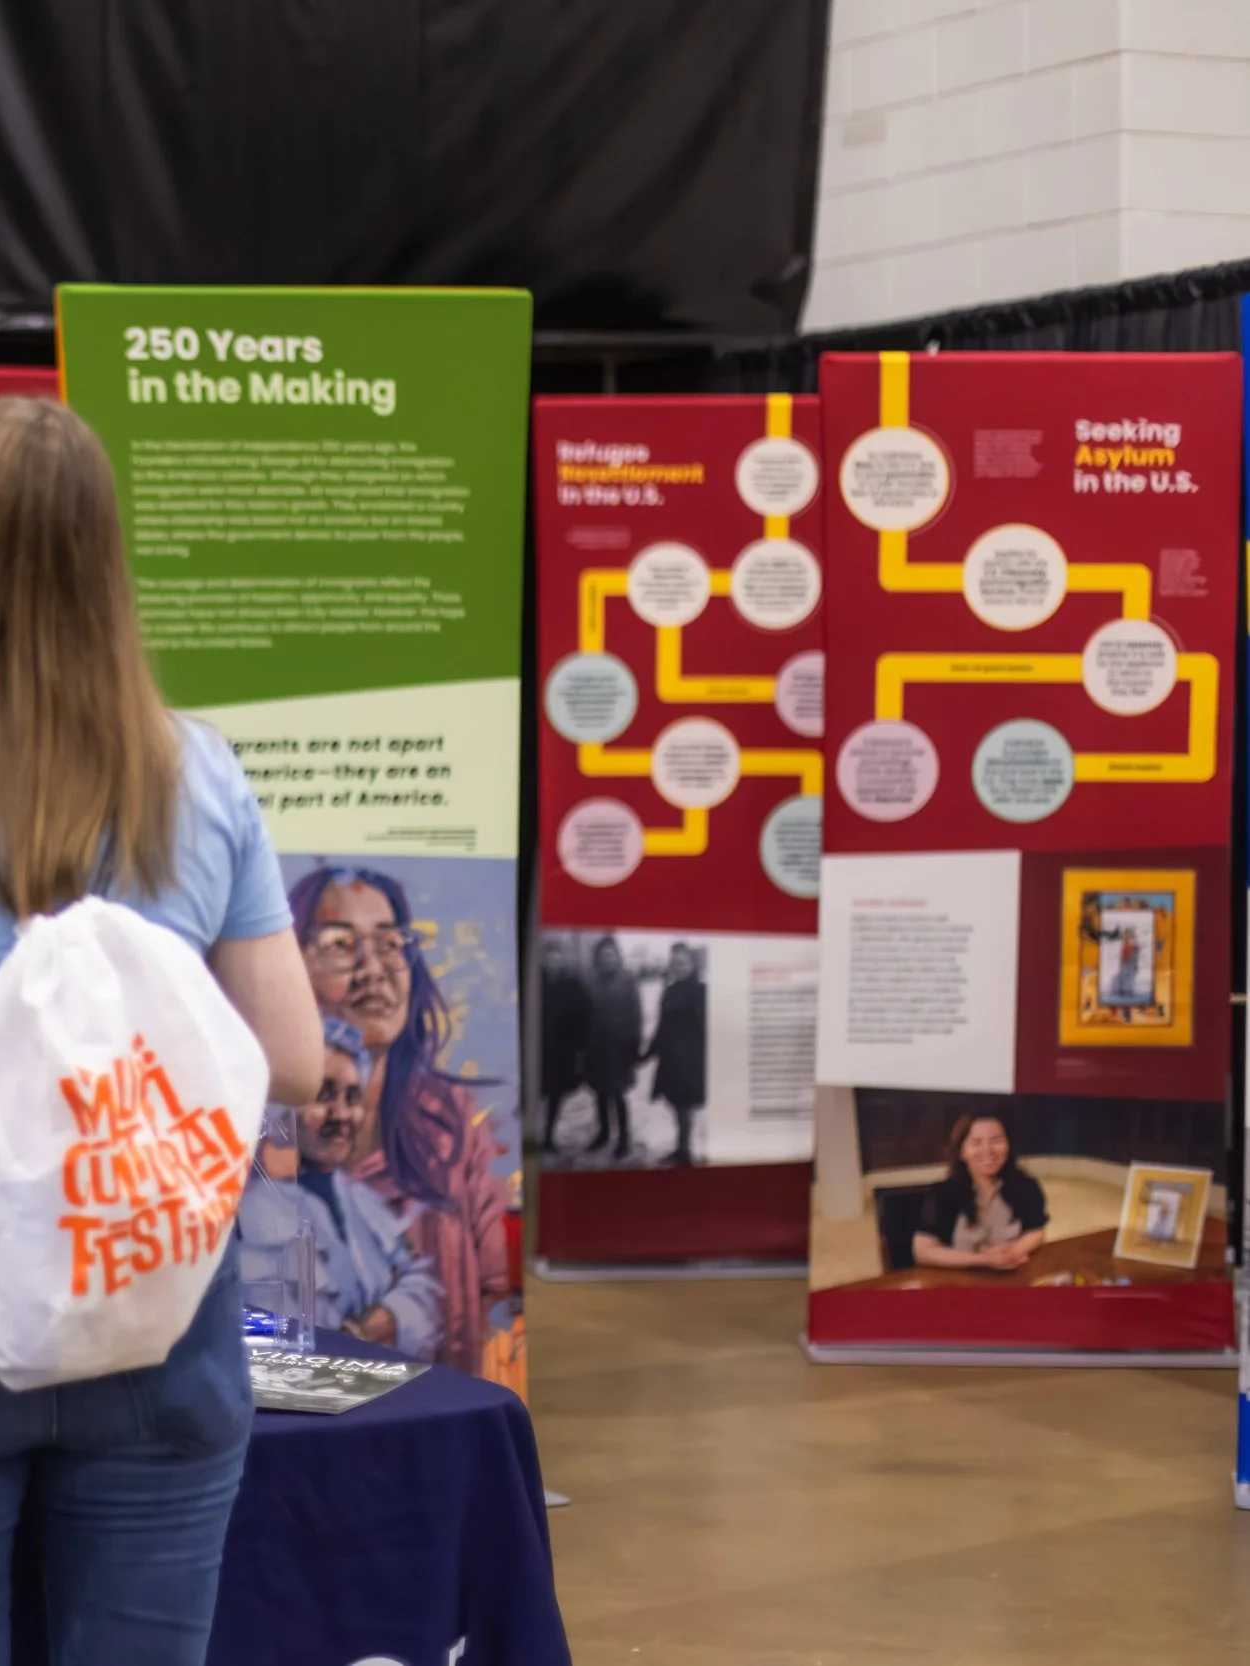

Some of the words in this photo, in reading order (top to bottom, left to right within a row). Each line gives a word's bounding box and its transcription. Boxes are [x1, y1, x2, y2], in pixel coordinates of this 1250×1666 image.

[124, 326, 200, 362] 250
[206, 329, 324, 363] Years
[127, 367, 167, 404] in
[174, 368, 242, 404] the
[248, 369, 398, 417] Making
[1074, 416, 1182, 448] Seeking
[1074, 443, 1175, 472] Asylum
[1073, 467, 1100, 493] in
[1102, 469, 1147, 493] the
[1150, 470, 1200, 493] U.S.
[306, 740, 341, 753] are
[347, 736, 381, 753] not
[388, 734, 445, 758] apart
[385, 764, 419, 779] are
[278, 792, 325, 814] part
[330, 790, 352, 807] of
[252, 1349, 408, 1373] VIRGINIA
